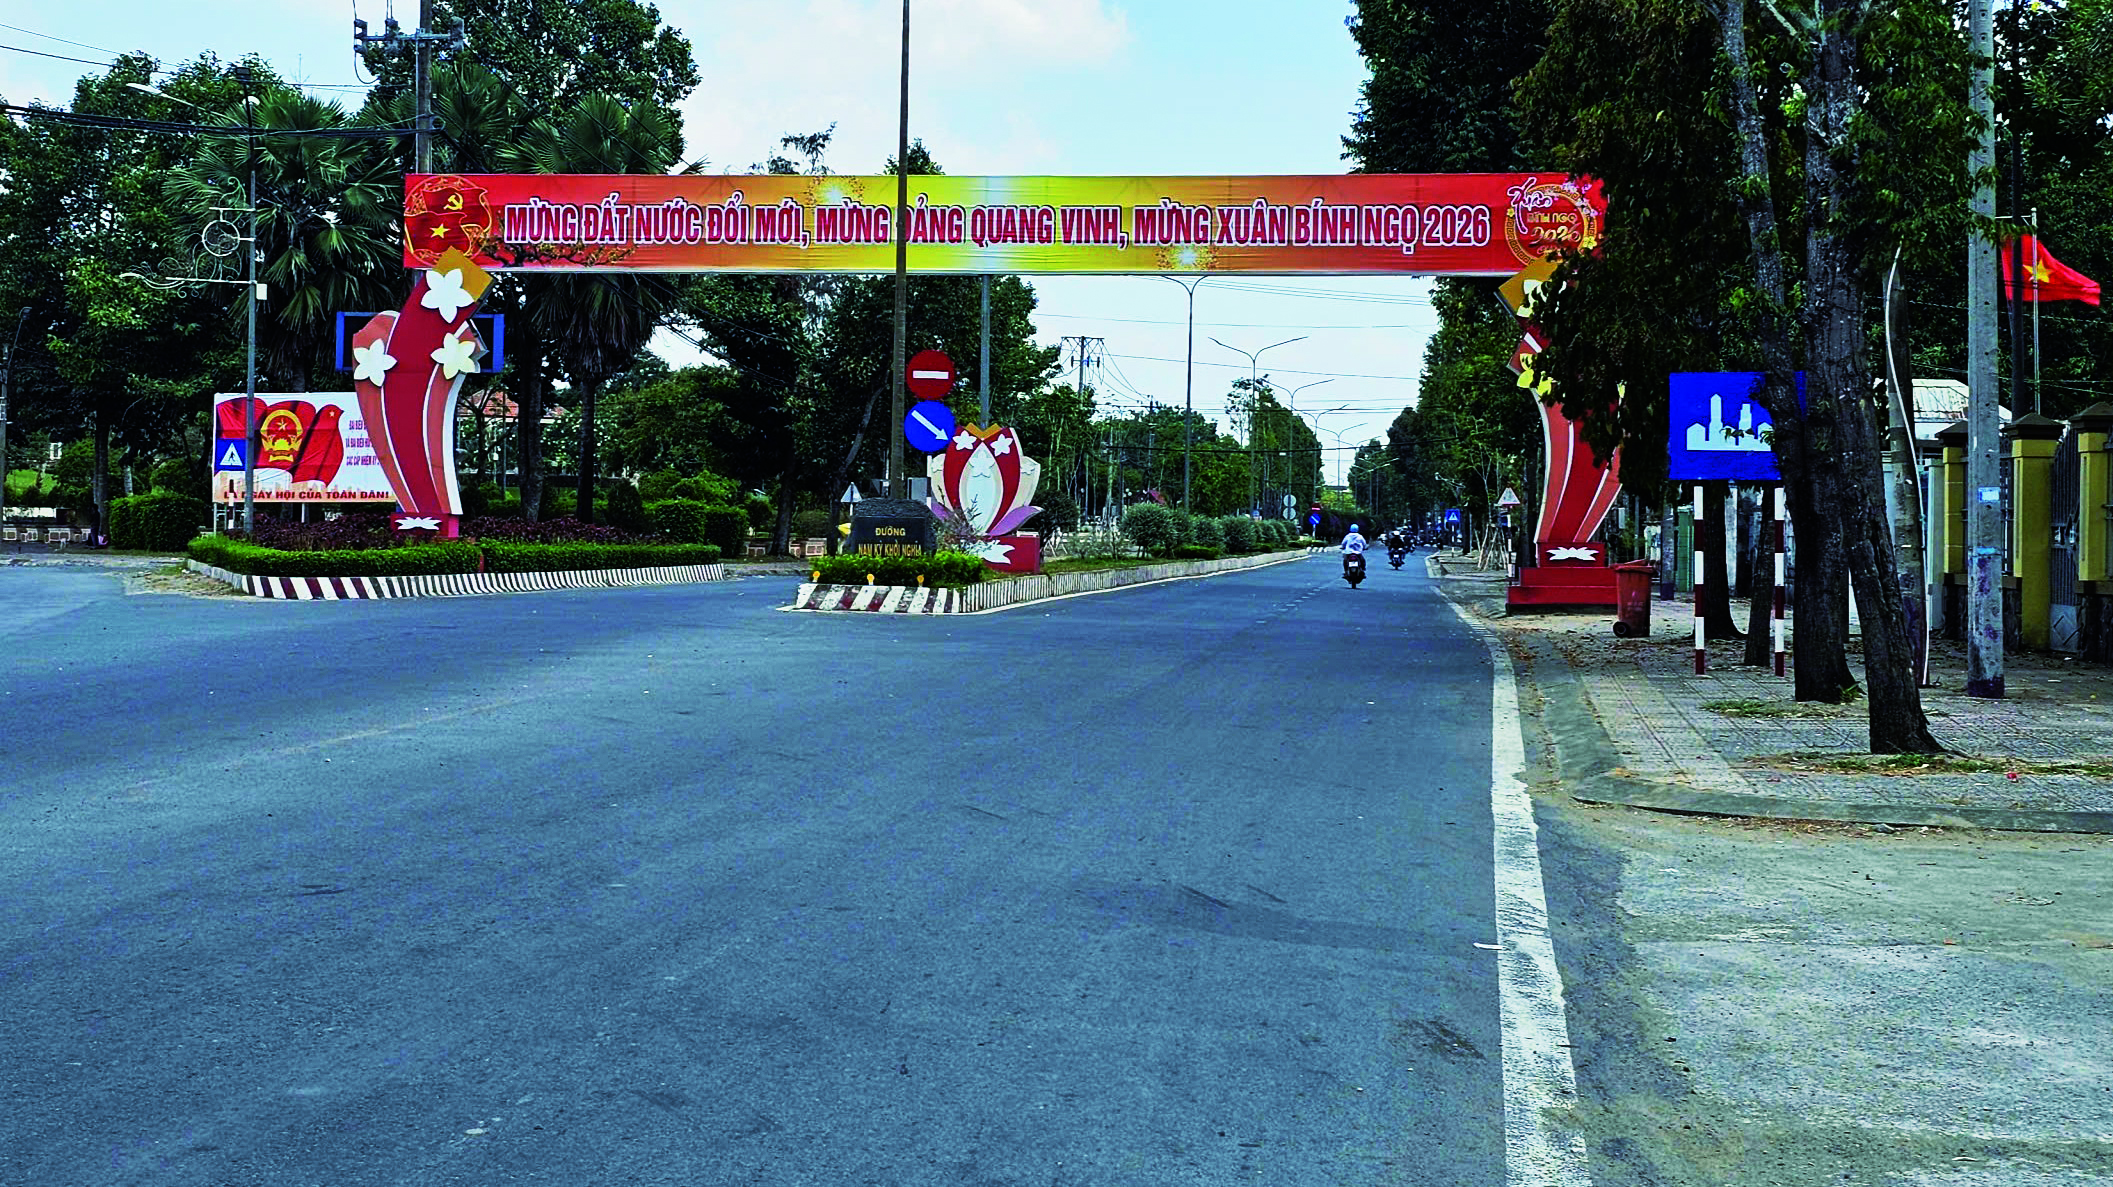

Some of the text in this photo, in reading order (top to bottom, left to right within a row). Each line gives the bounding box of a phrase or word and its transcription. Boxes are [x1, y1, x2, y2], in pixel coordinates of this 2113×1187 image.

[505, 197, 578, 244] MỪNG
[582, 192, 630, 244] ĐẤT
[634, 197, 702, 244] NƯỚC
[706, 190, 748, 244] ĐỔI
[753, 197, 809, 249] MỚI,
[814, 197, 891, 244] MỪNG
[970, 205, 1056, 248] QUANG
[1060, 205, 1129, 249] VINH,
[1133, 198, 1211, 246] MỪNG
[1215, 198, 1287, 246] XUÂN
[1292, 198, 1358, 246] BÍNH
[1363, 206, 1418, 254] NGỌ
[1423, 206, 1490, 246] 2026
[1528, 224, 1581, 245] 2026
[275, 490, 295, 500] HỘI
[299, 488, 322, 499] CỦA
[326, 489, 357, 499] TOÀN
[875, 525, 906, 536] ĐƯỜNG
